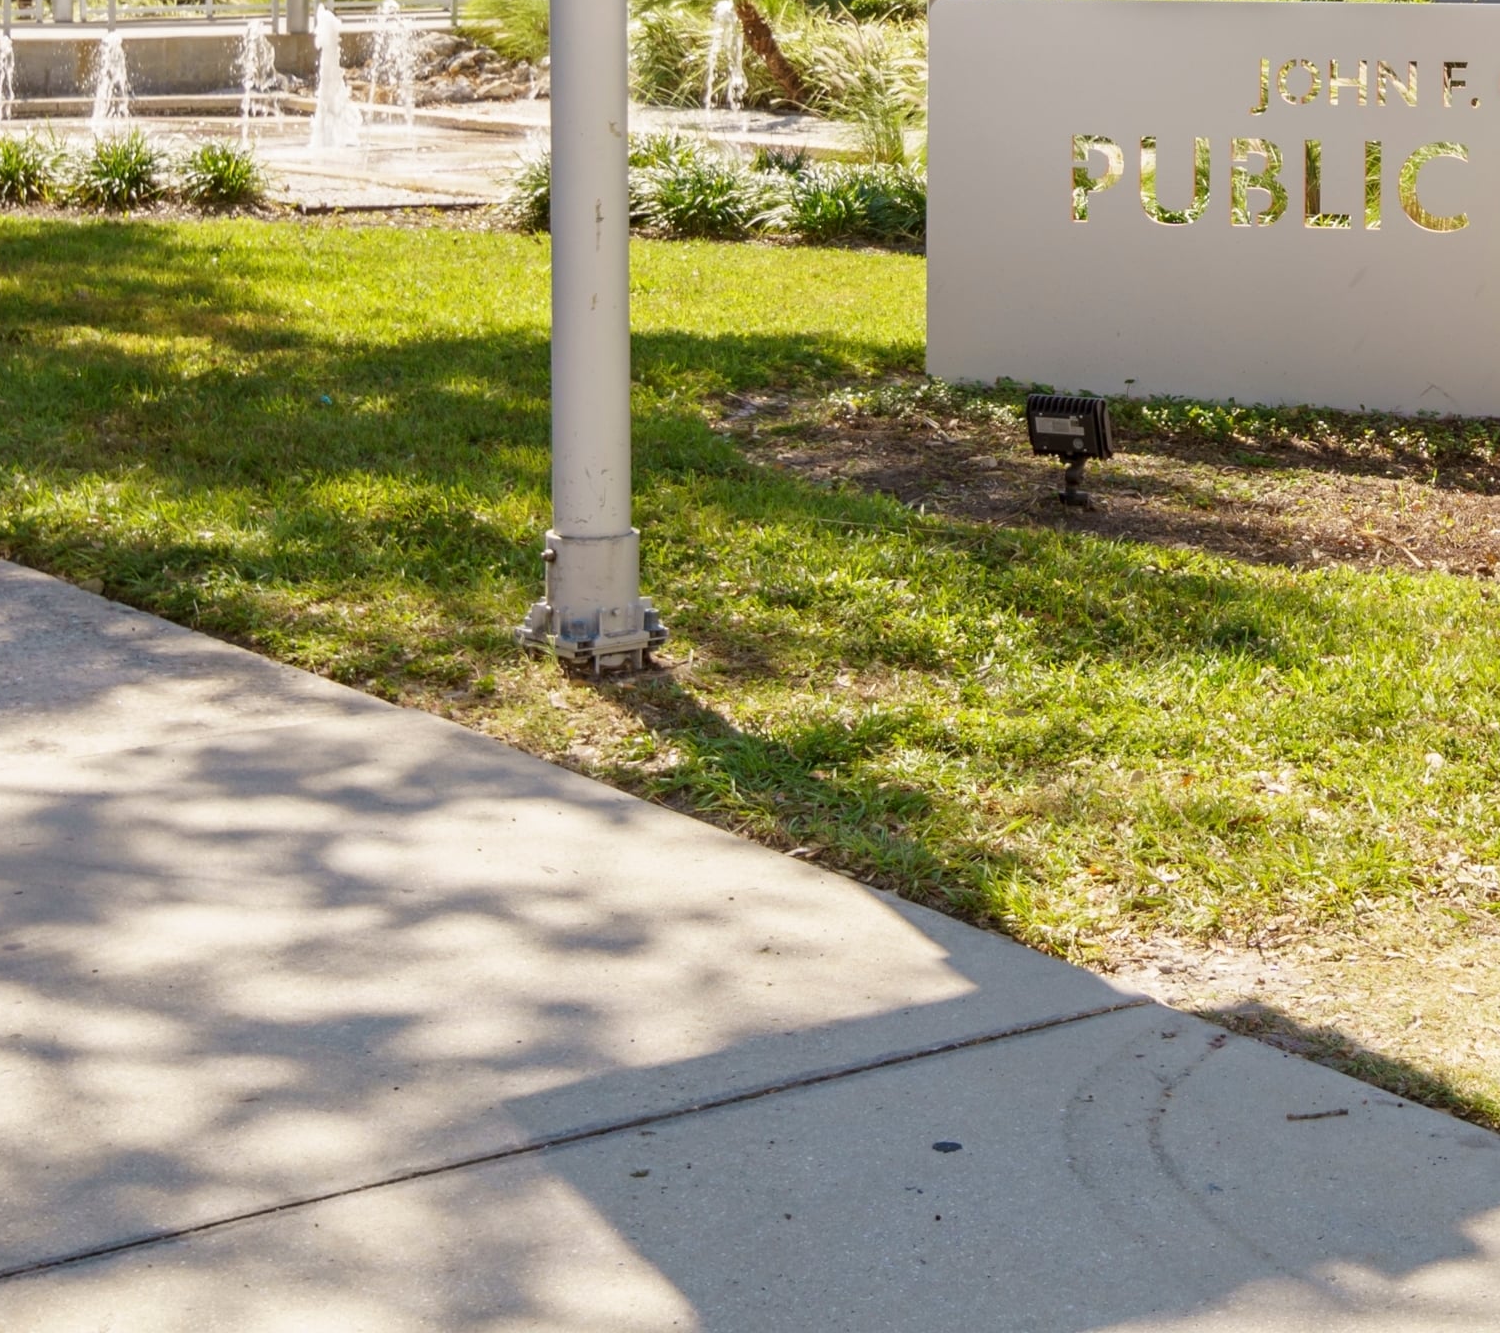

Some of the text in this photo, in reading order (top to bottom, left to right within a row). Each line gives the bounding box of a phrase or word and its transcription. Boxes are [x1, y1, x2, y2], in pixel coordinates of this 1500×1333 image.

[1250, 57, 1419, 117] JOHN
[1442, 60, 1481, 109] F.
[1071, 134, 1471, 233] PUBLIC
